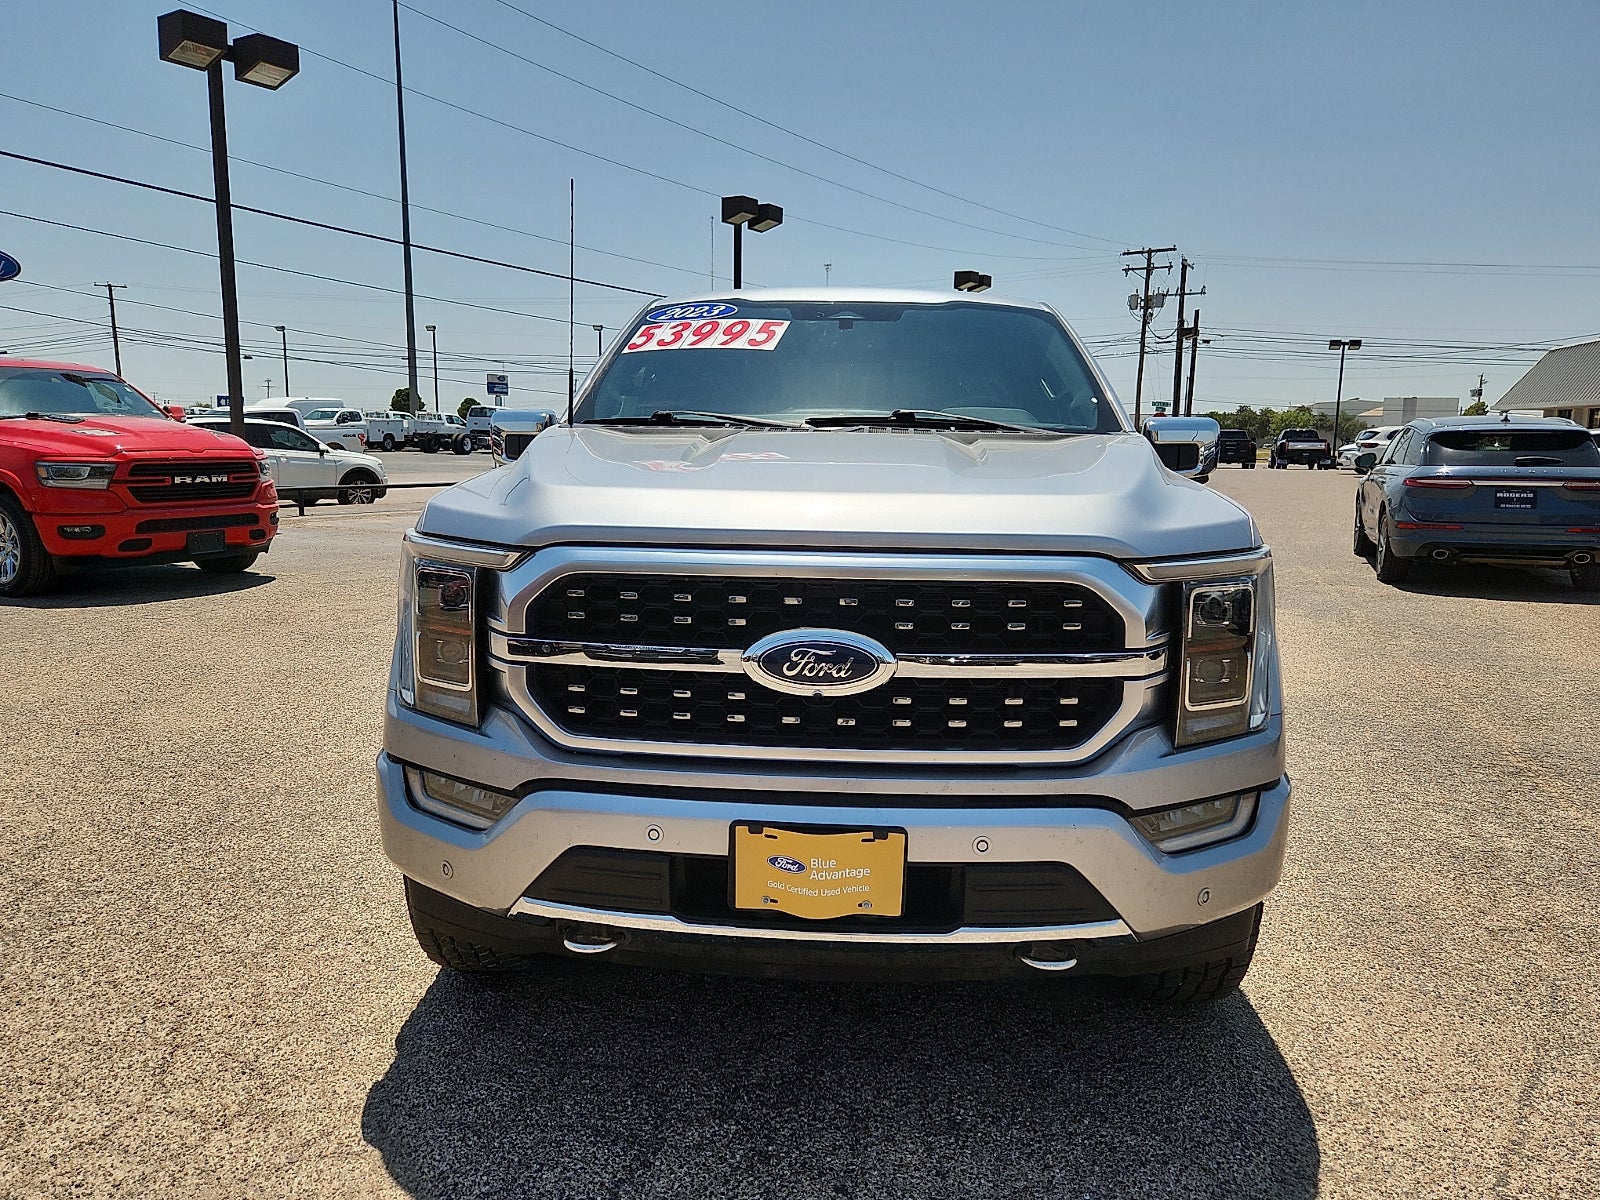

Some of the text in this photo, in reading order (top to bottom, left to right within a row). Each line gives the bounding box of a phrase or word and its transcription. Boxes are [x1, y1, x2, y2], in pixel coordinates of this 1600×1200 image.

[656, 305, 727, 320] 2023
[628, 320, 785, 350] 53995
[174, 475, 228, 483] RAM
[783, 648, 854, 678] Ford
[775, 857, 799, 872] Ford
[810, 858, 837, 869] Blue
[809, 866, 871, 881] Advantage
[767, 880, 870, 896] Gold Certified Used Vehicle
